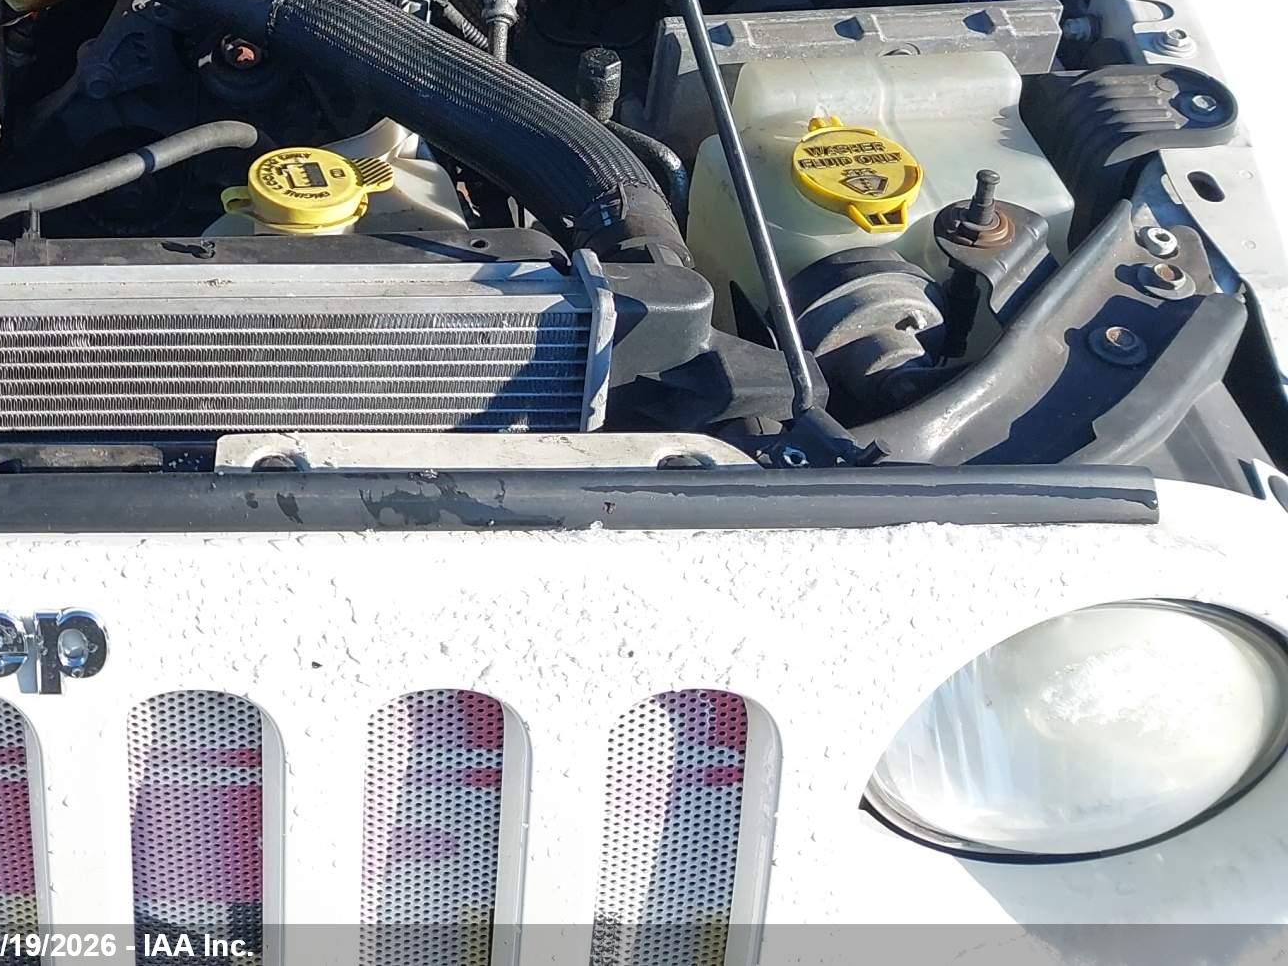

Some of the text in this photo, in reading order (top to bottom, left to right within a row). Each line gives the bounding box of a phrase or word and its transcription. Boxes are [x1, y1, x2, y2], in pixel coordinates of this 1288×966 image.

[804, 142, 886, 156] WASHER
[797, 152, 901, 170] FLUID ONLY
